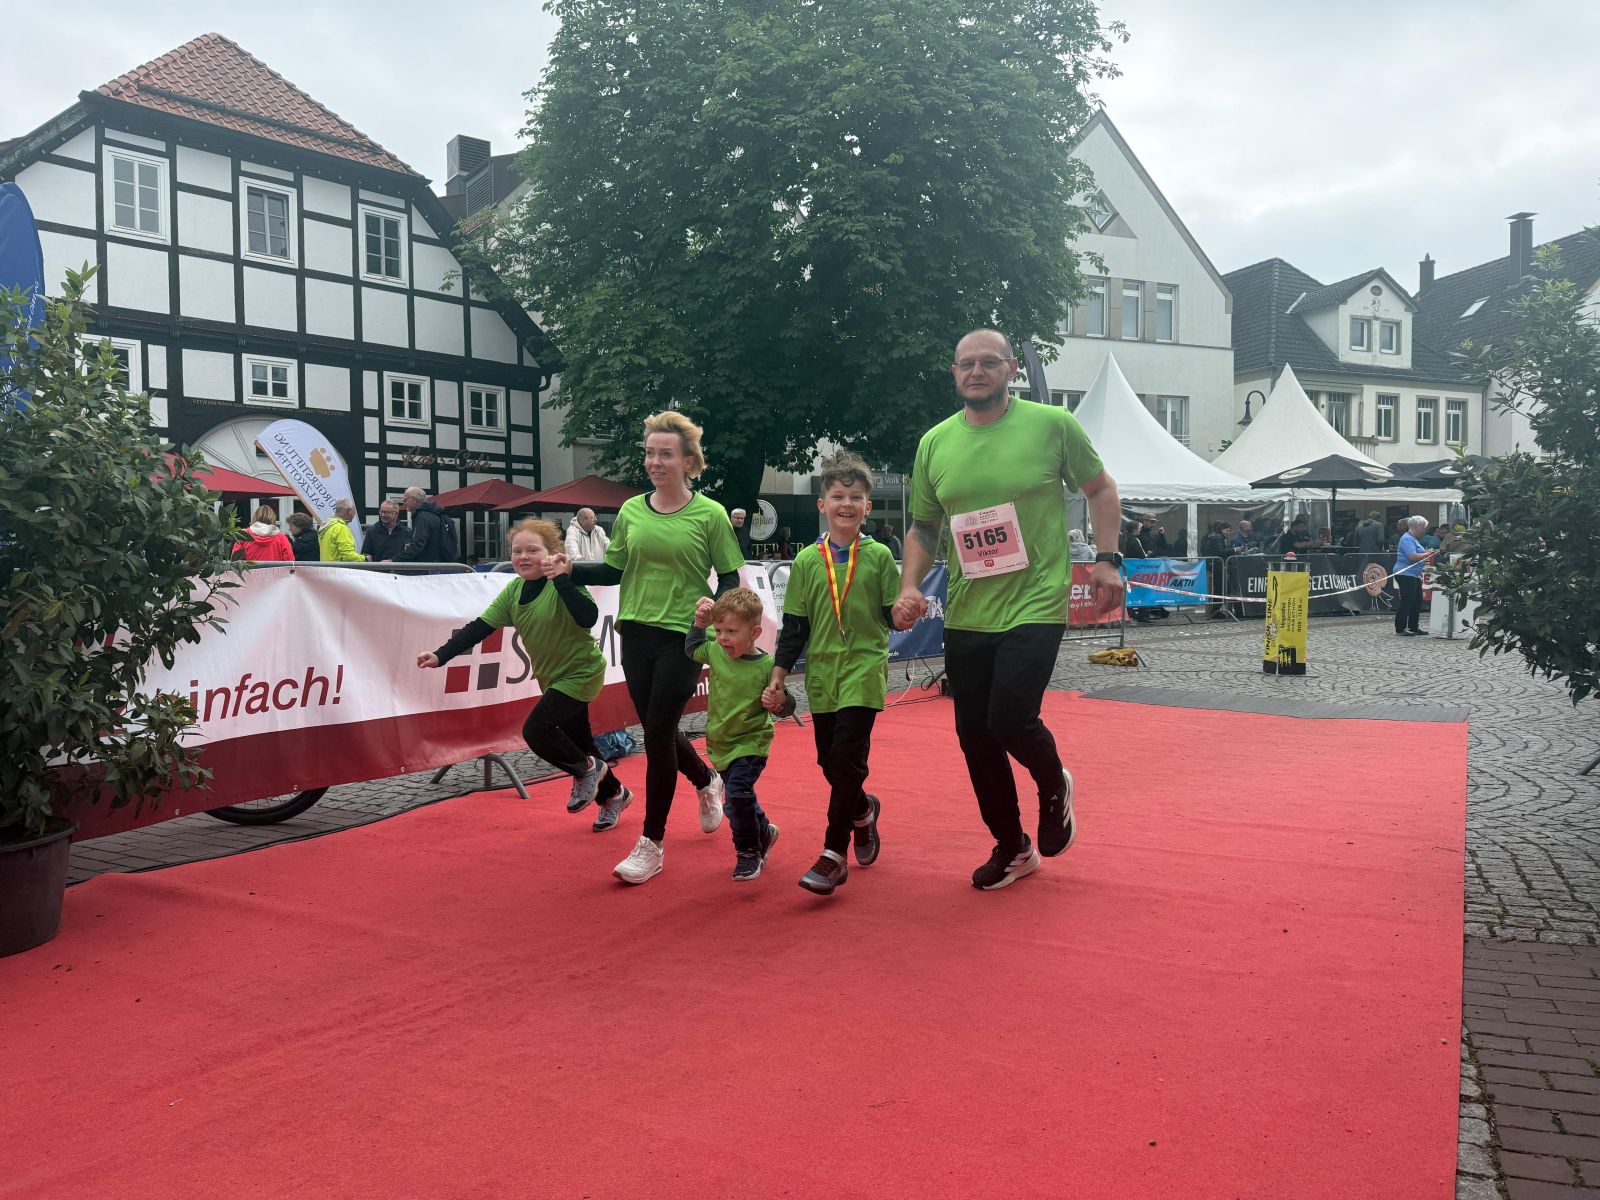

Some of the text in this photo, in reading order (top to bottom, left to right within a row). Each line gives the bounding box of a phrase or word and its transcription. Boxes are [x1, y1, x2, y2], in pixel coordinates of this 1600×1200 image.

[963, 526, 1008, 549] 5165
[977, 548, 999, 557] Viktor
[1170, 578, 1197, 588] AKTIV
[1248, 574, 1357, 592] EINF GEZEICHNET
[188, 664, 344, 724] infach!
